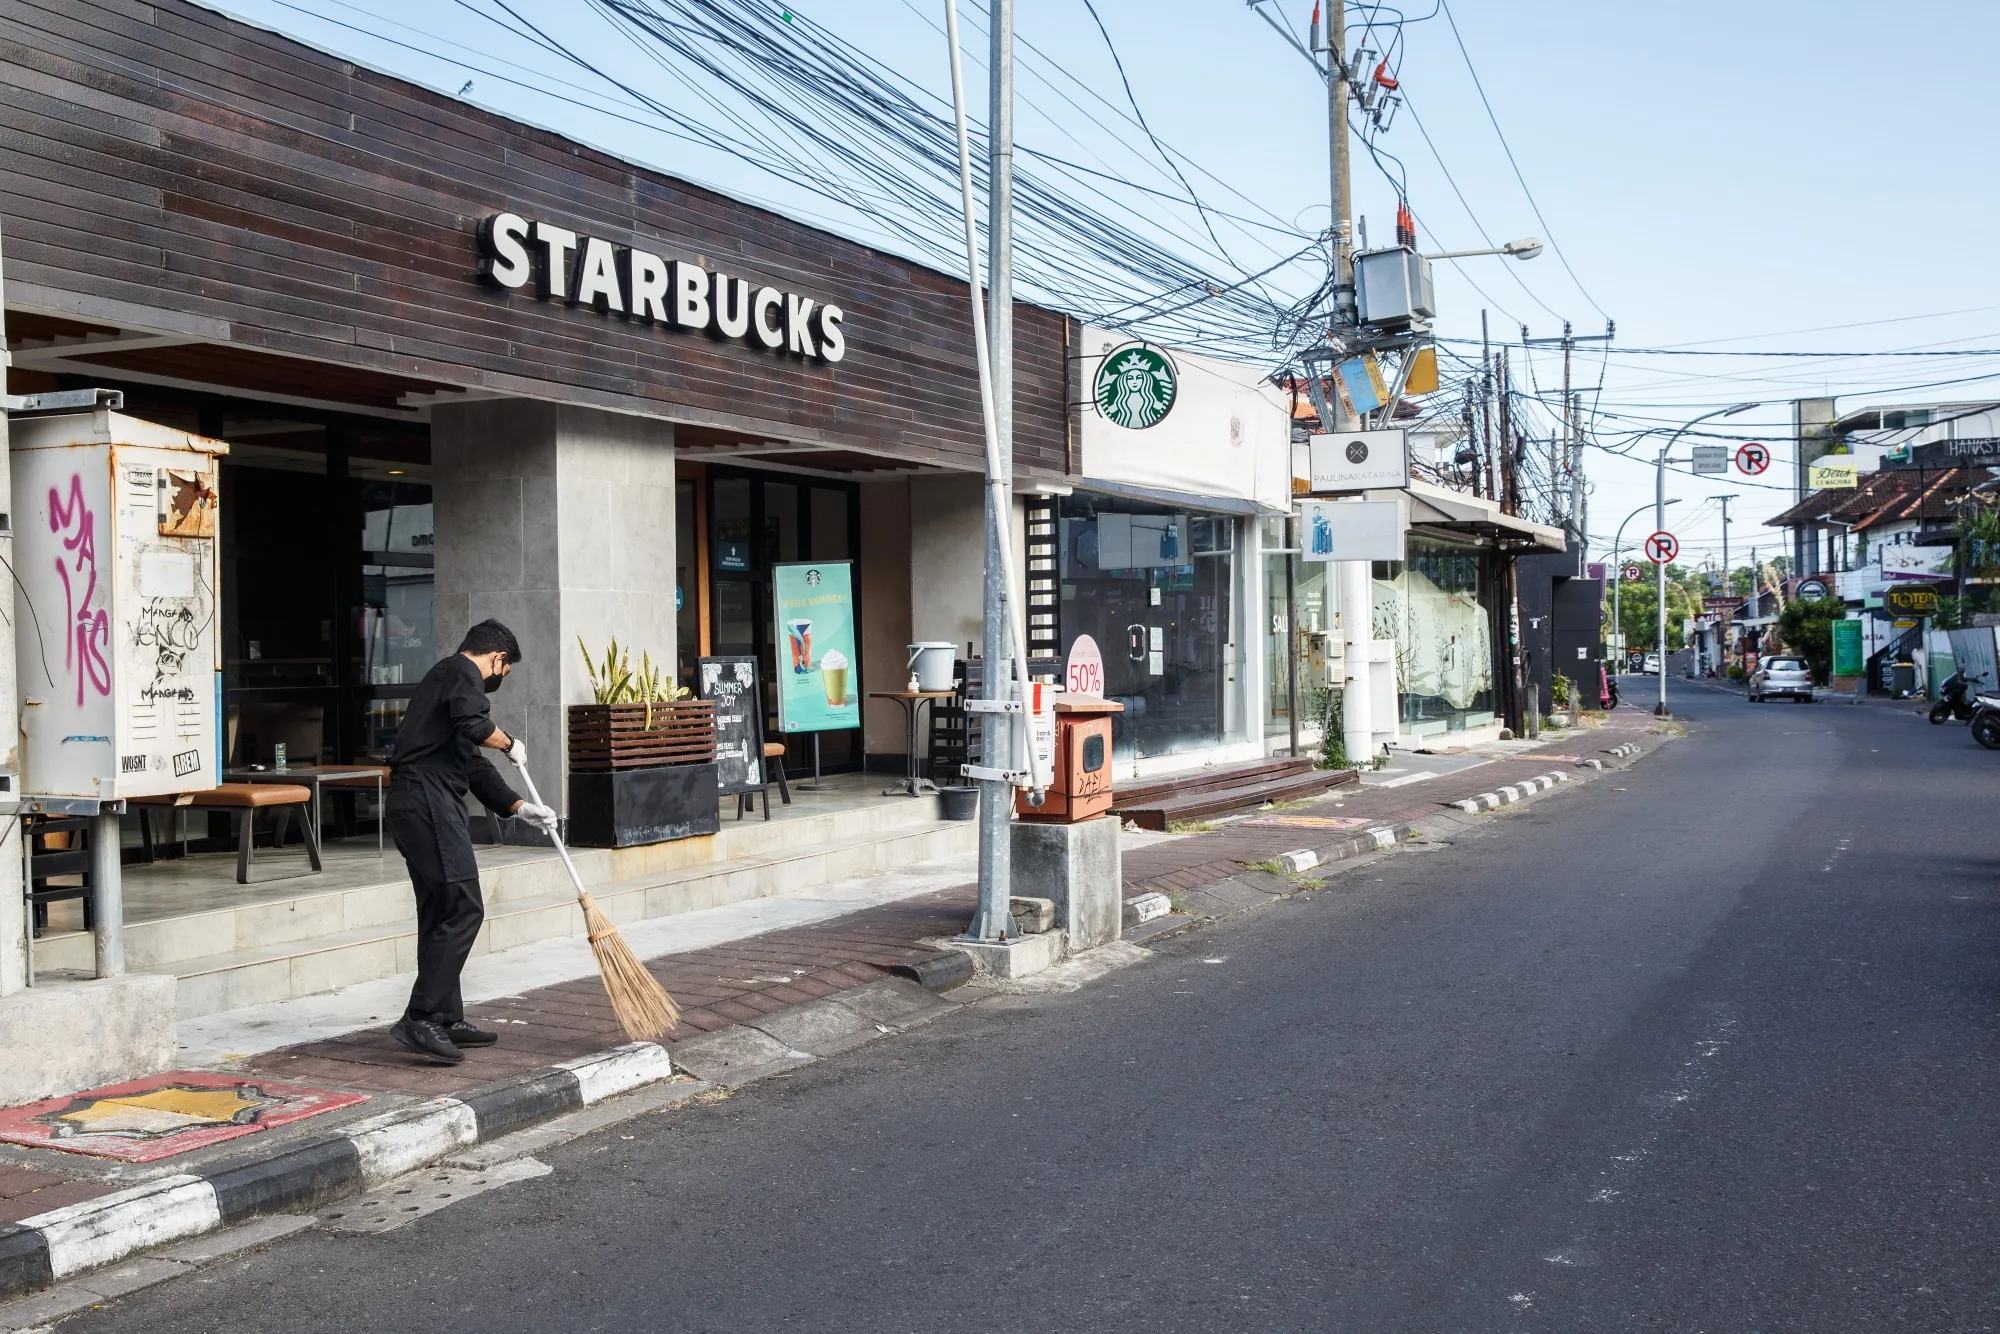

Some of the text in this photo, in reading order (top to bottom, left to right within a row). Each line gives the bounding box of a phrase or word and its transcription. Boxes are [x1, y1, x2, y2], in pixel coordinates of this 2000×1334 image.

[491, 212, 846, 362] STARBUCKS
[1949, 438, 1994, 457] HANKS
[1314, 470, 1402, 483] PAULINAKATARINA
[1816, 468, 1851, 479] Deus
[1070, 662, 1101, 693] 50%
[714, 681, 743, 695] SUMMER
[720, 694, 736, 708] JOY
[173, 749, 200, 777] AREM
